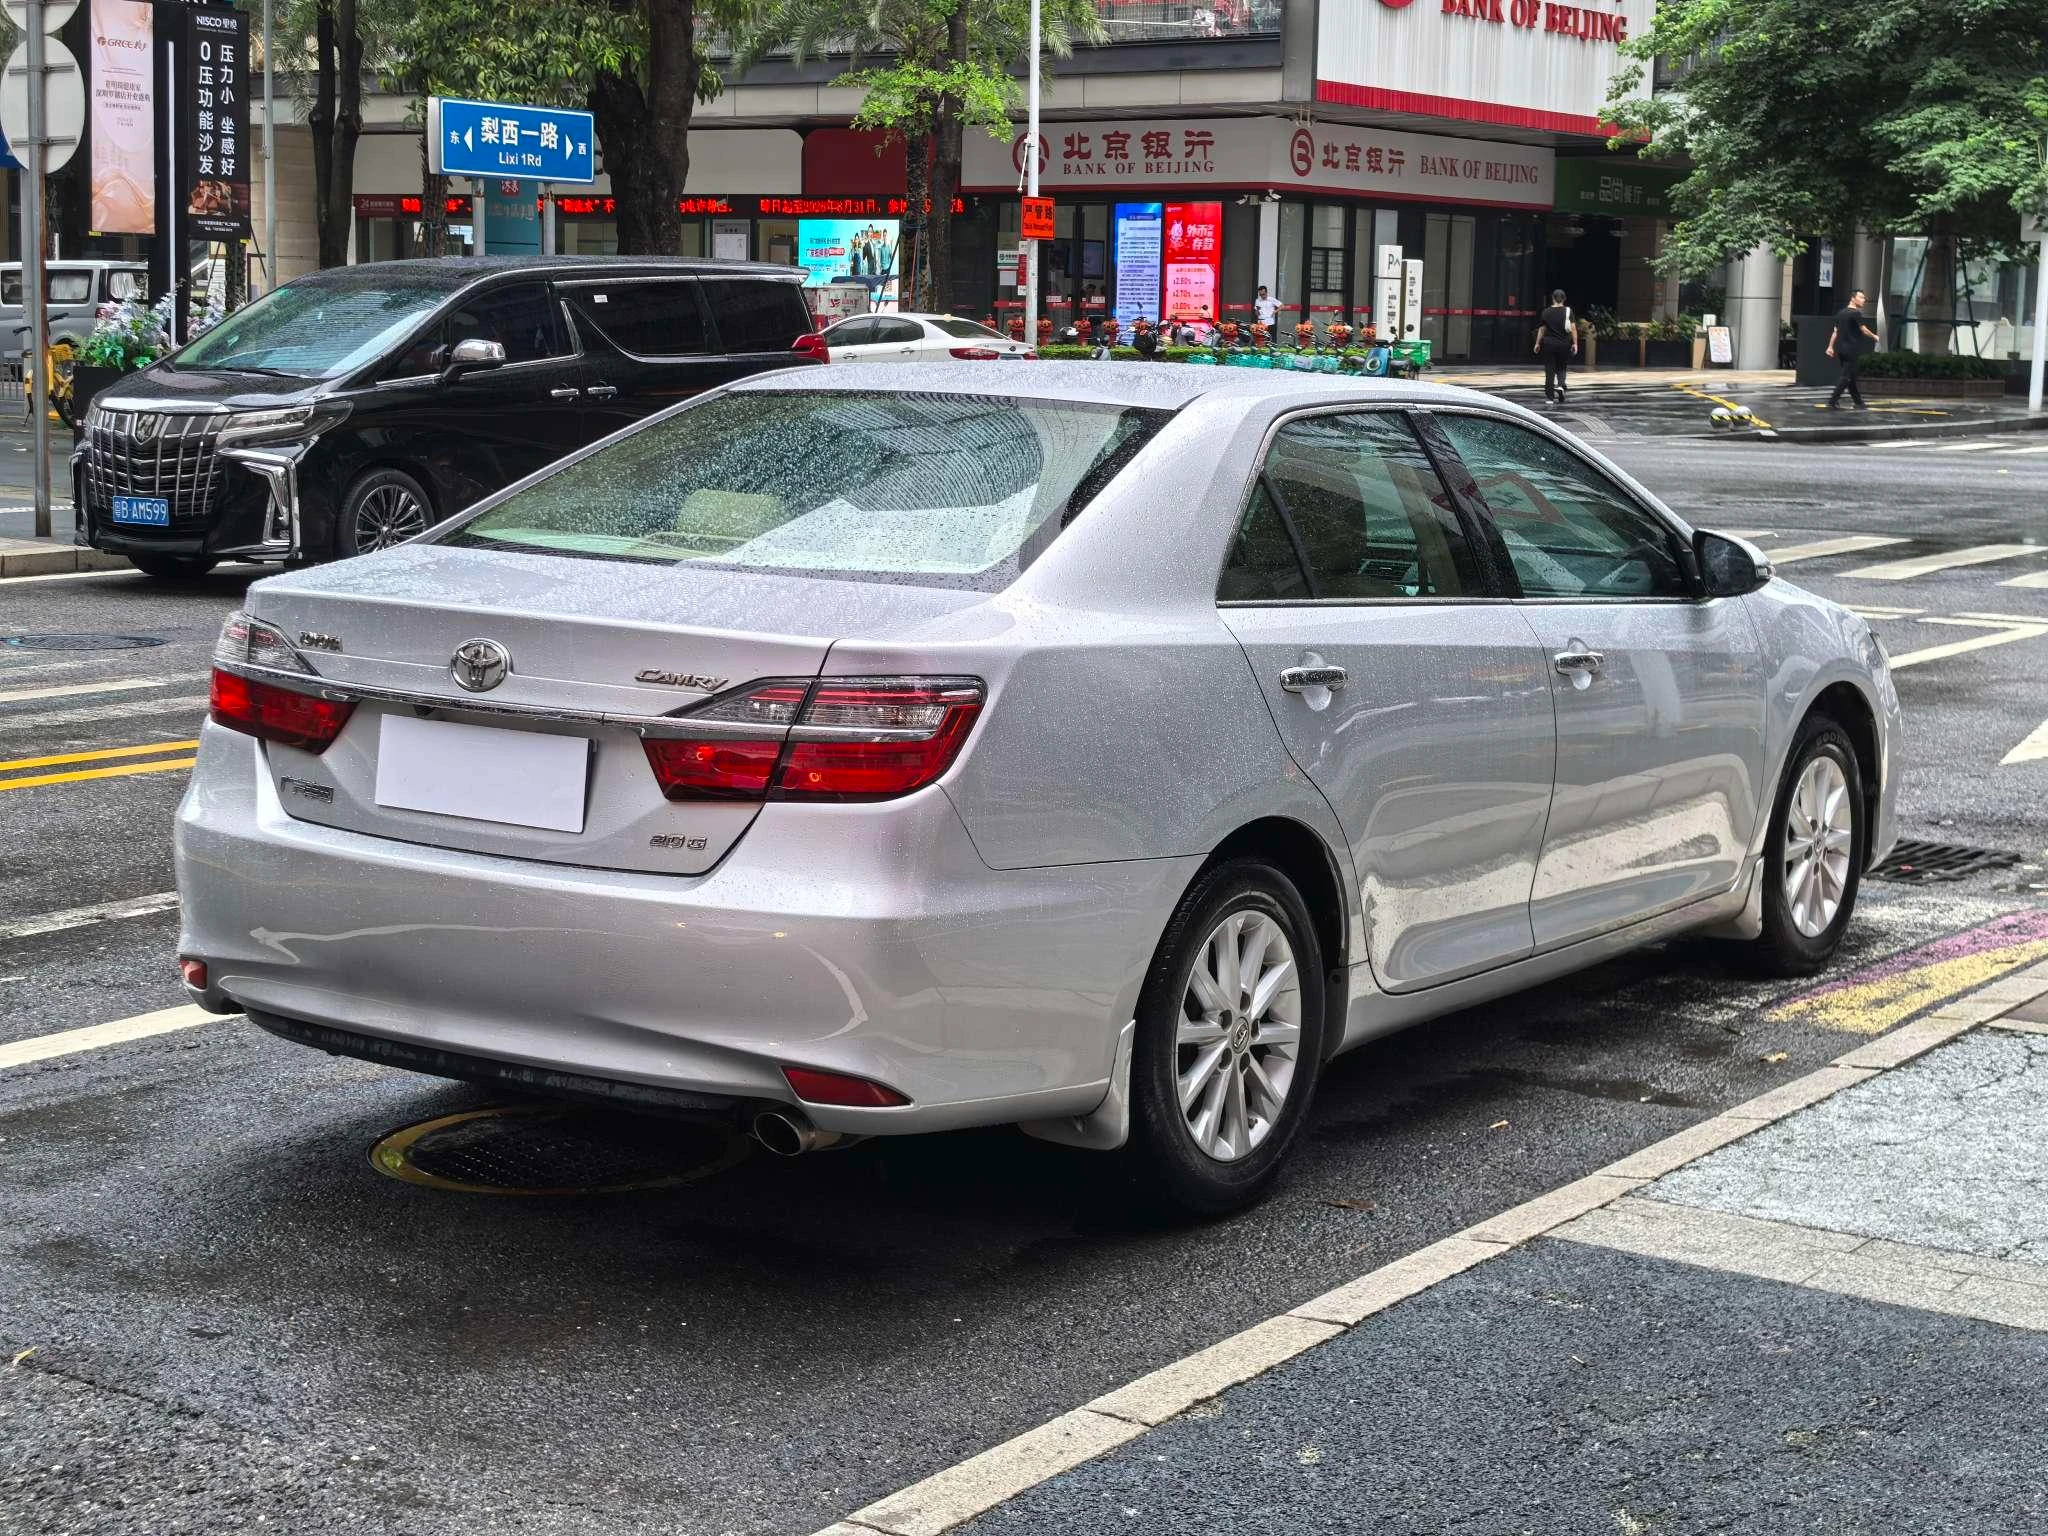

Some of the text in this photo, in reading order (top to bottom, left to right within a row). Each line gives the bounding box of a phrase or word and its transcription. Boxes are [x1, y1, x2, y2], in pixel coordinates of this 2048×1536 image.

[196, 15, 222, 27] NISCO
[1511, 0, 1540, 28] OF
[1544, 3, 1627, 44] BEIJING
[220, 44, 234, 104] 压力小
[199, 41, 214, 175] 0压功能沙发
[220, 116, 235, 176] 坐感好
[450, 117, 587, 155] 东 梨西一路 西
[1063, 129, 1215, 160] 北京银行
[498, 152, 542, 168] Lixi 1Rd
[1063, 160, 1215, 175] BANK OF BEIJING
[1322, 141, 1405, 177] 北京银行
[1420, 155, 1538, 184] BANK OF BEIJING
[635, 668, 729, 692] CAMRY
